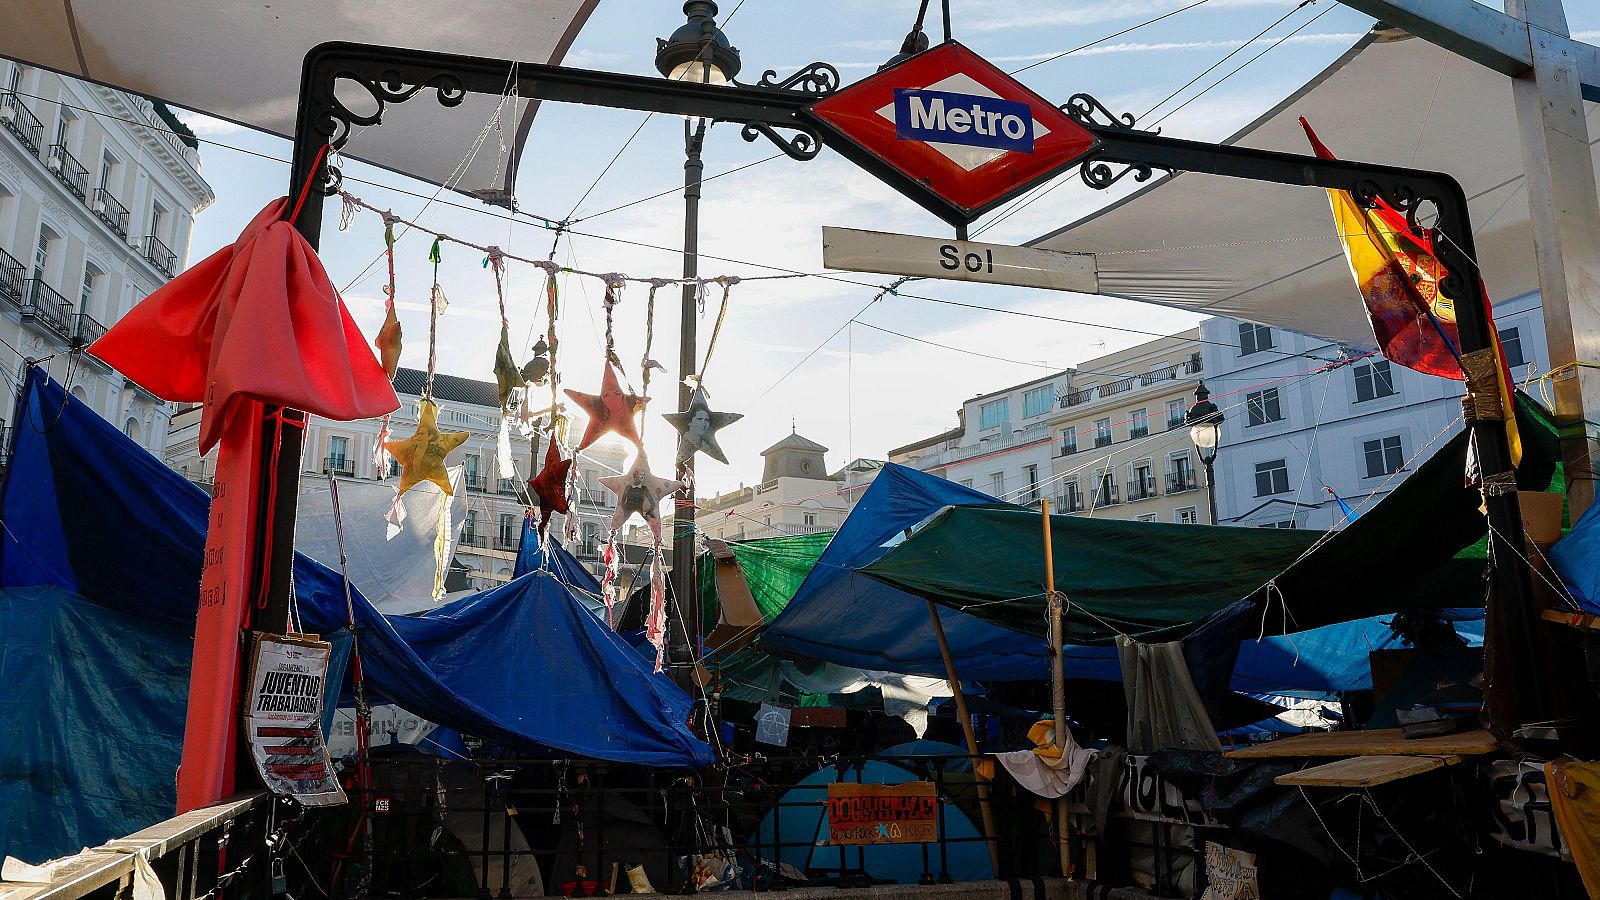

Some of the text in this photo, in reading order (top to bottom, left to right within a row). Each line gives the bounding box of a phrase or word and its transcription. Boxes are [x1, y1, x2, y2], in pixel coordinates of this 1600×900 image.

[909, 96, 1026, 140] Metro
[939, 244, 993, 274] Sol
[259, 671, 321, 698] JUVENTUD
[256, 694, 320, 714] TRABAJADORA
[904, 824, 934, 839] KKR
